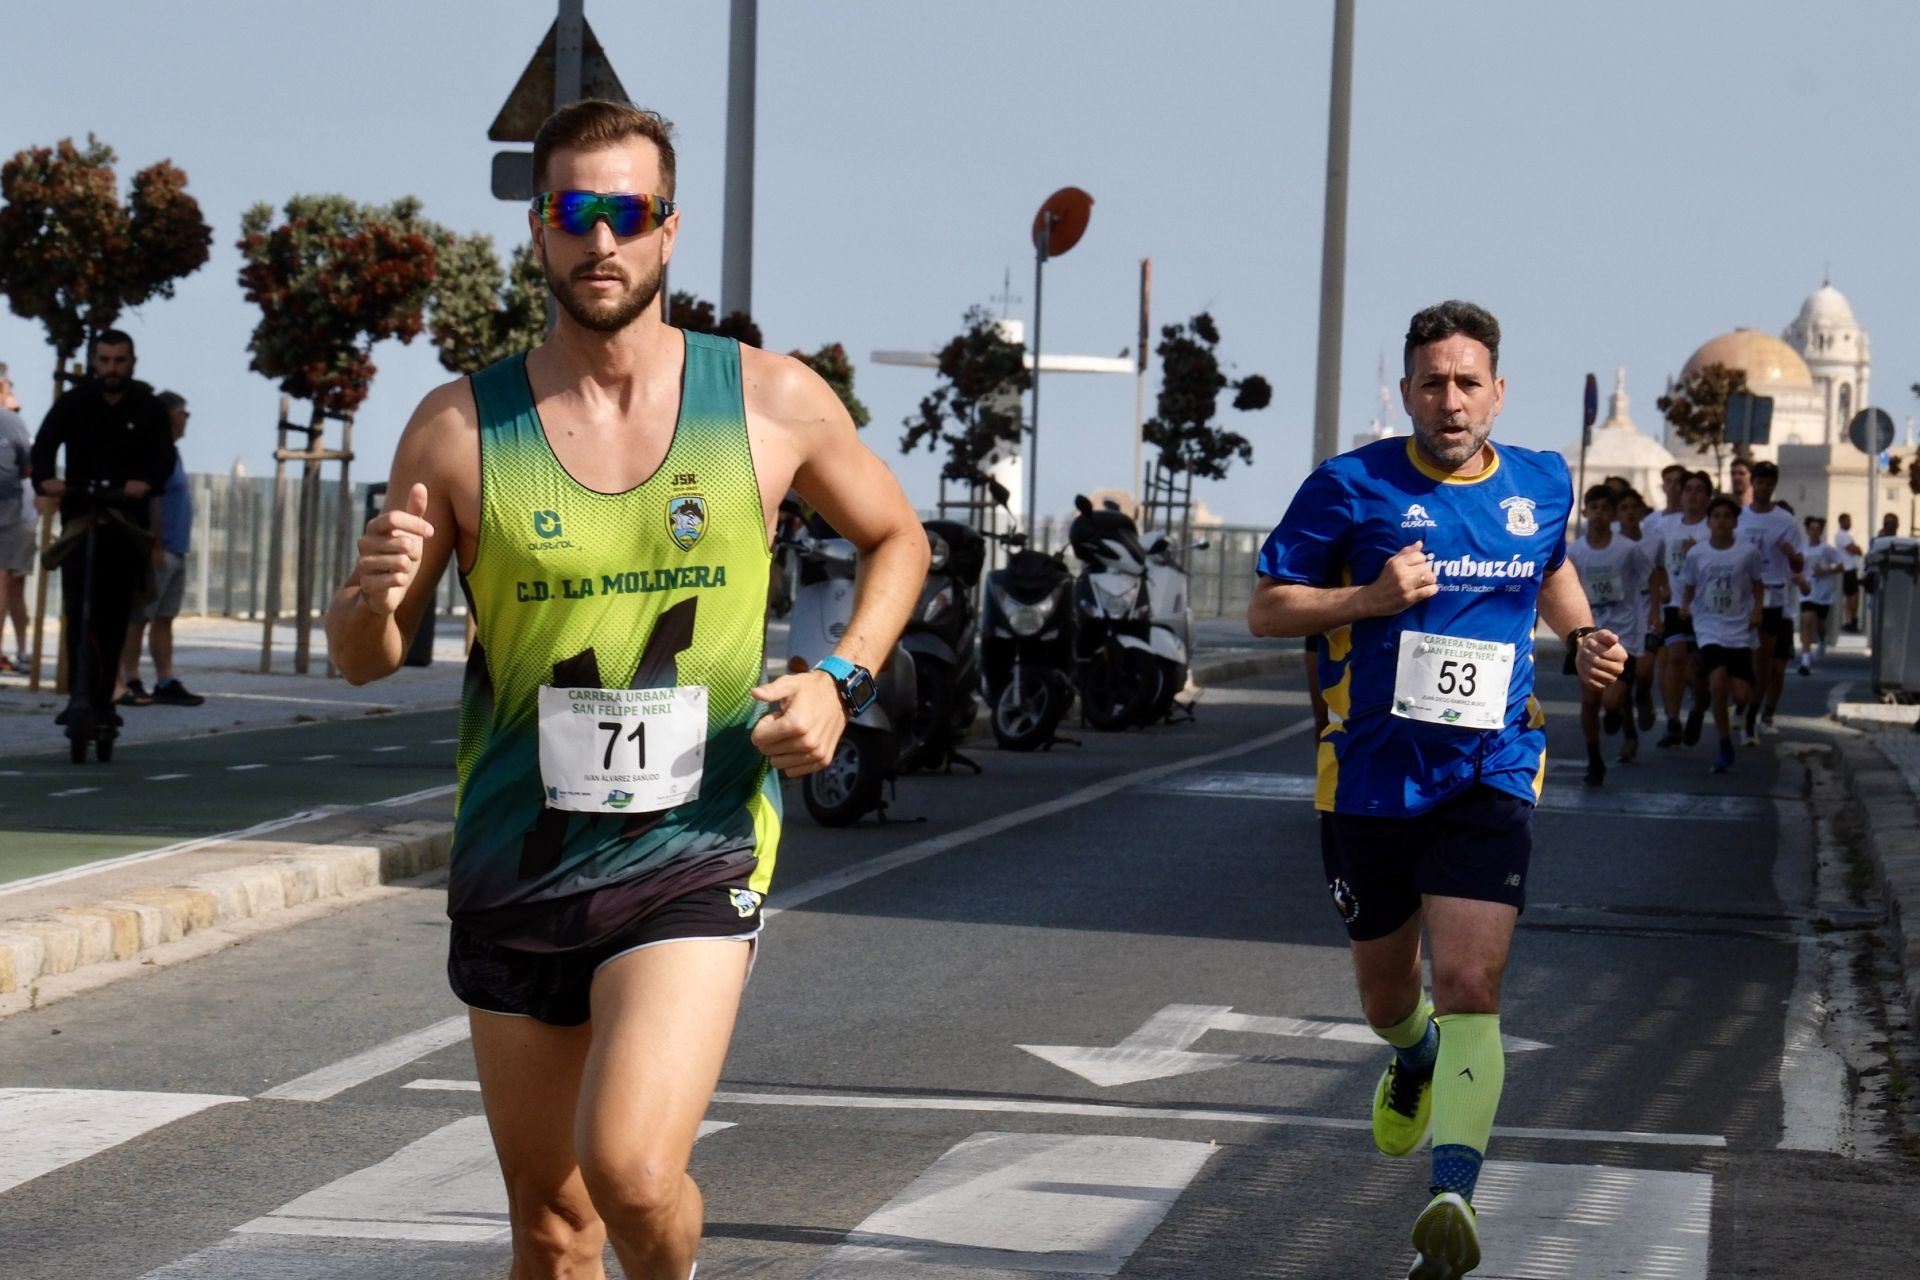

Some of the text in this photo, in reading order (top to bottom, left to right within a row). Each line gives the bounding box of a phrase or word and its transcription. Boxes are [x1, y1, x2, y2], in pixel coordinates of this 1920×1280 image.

[672, 474, 698, 486] JSR
[1425, 552, 1536, 579] irabuzón
[516, 566, 727, 603] C.D. LA MOLINERA
[1424, 635, 1498, 652] CARRERA URBANA
[1444, 648, 1474, 660] FELIPE
[1475, 652, 1495, 661] NERI
[1437, 660, 1478, 697] 53
[568, 689, 676, 702] CARRERA URBANA
[572, 703, 672, 716] SAN FELIPE NERI
[598, 721, 646, 770] 71
